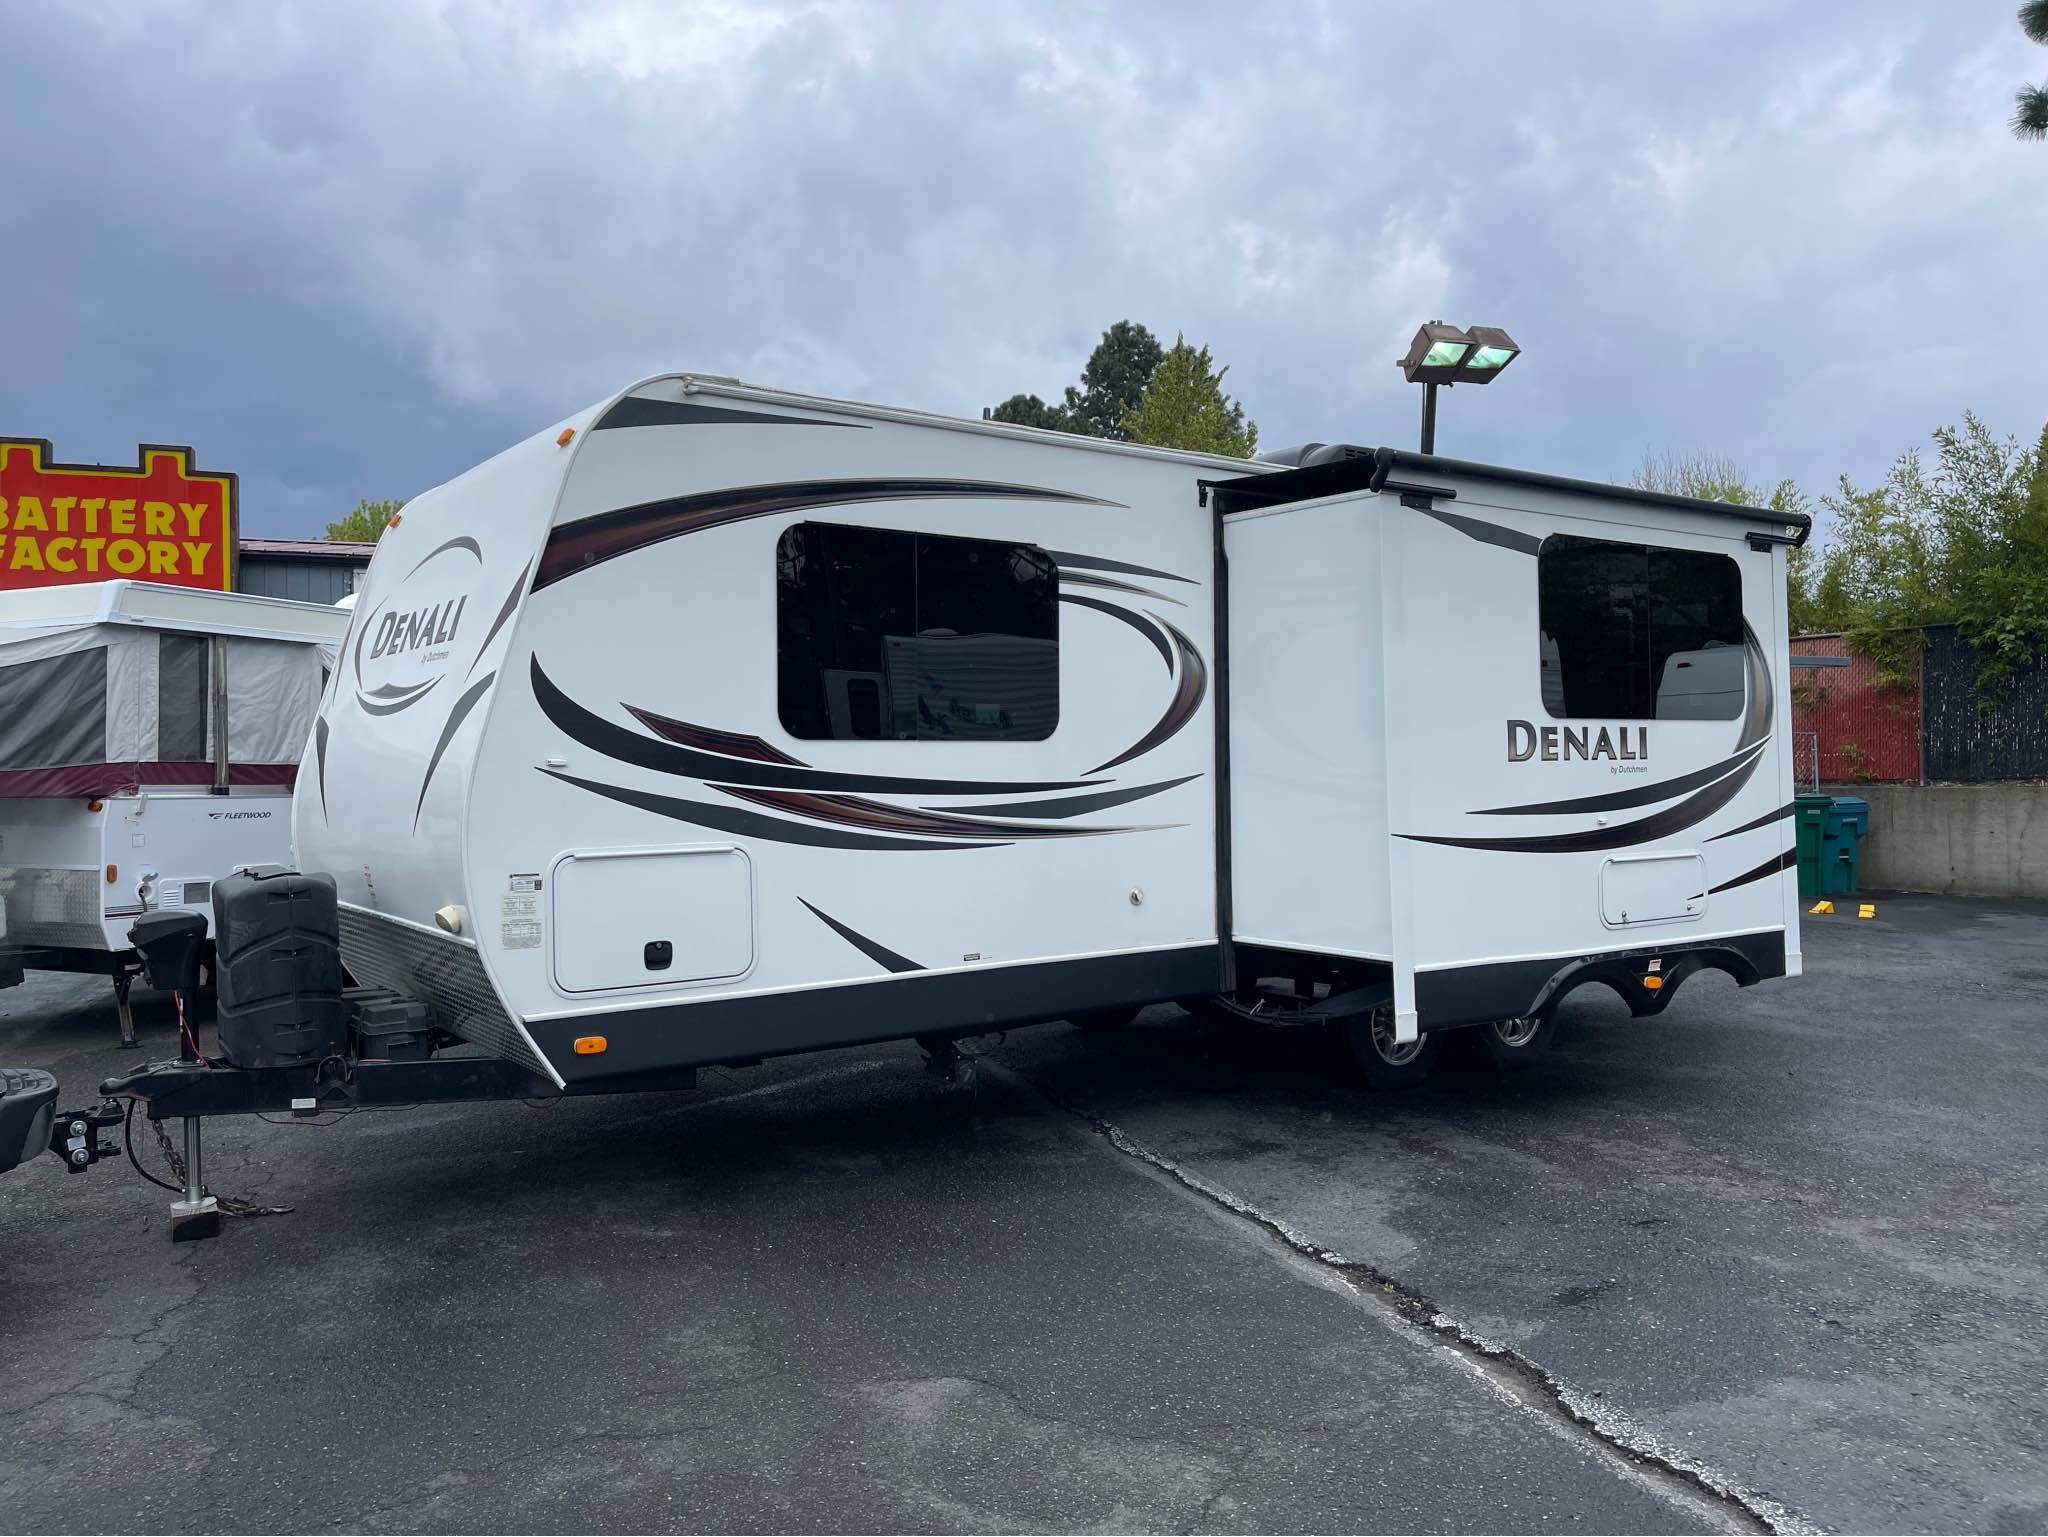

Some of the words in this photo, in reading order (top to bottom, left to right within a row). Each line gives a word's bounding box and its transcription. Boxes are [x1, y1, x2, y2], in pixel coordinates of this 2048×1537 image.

[0, 535, 213, 575] ACTORY
[370, 594, 468, 660] DENALI
[1506, 719, 1648, 762] DENALI
[1611, 766, 1618, 775] by
[1619, 765, 1648, 773] Dutchmen
